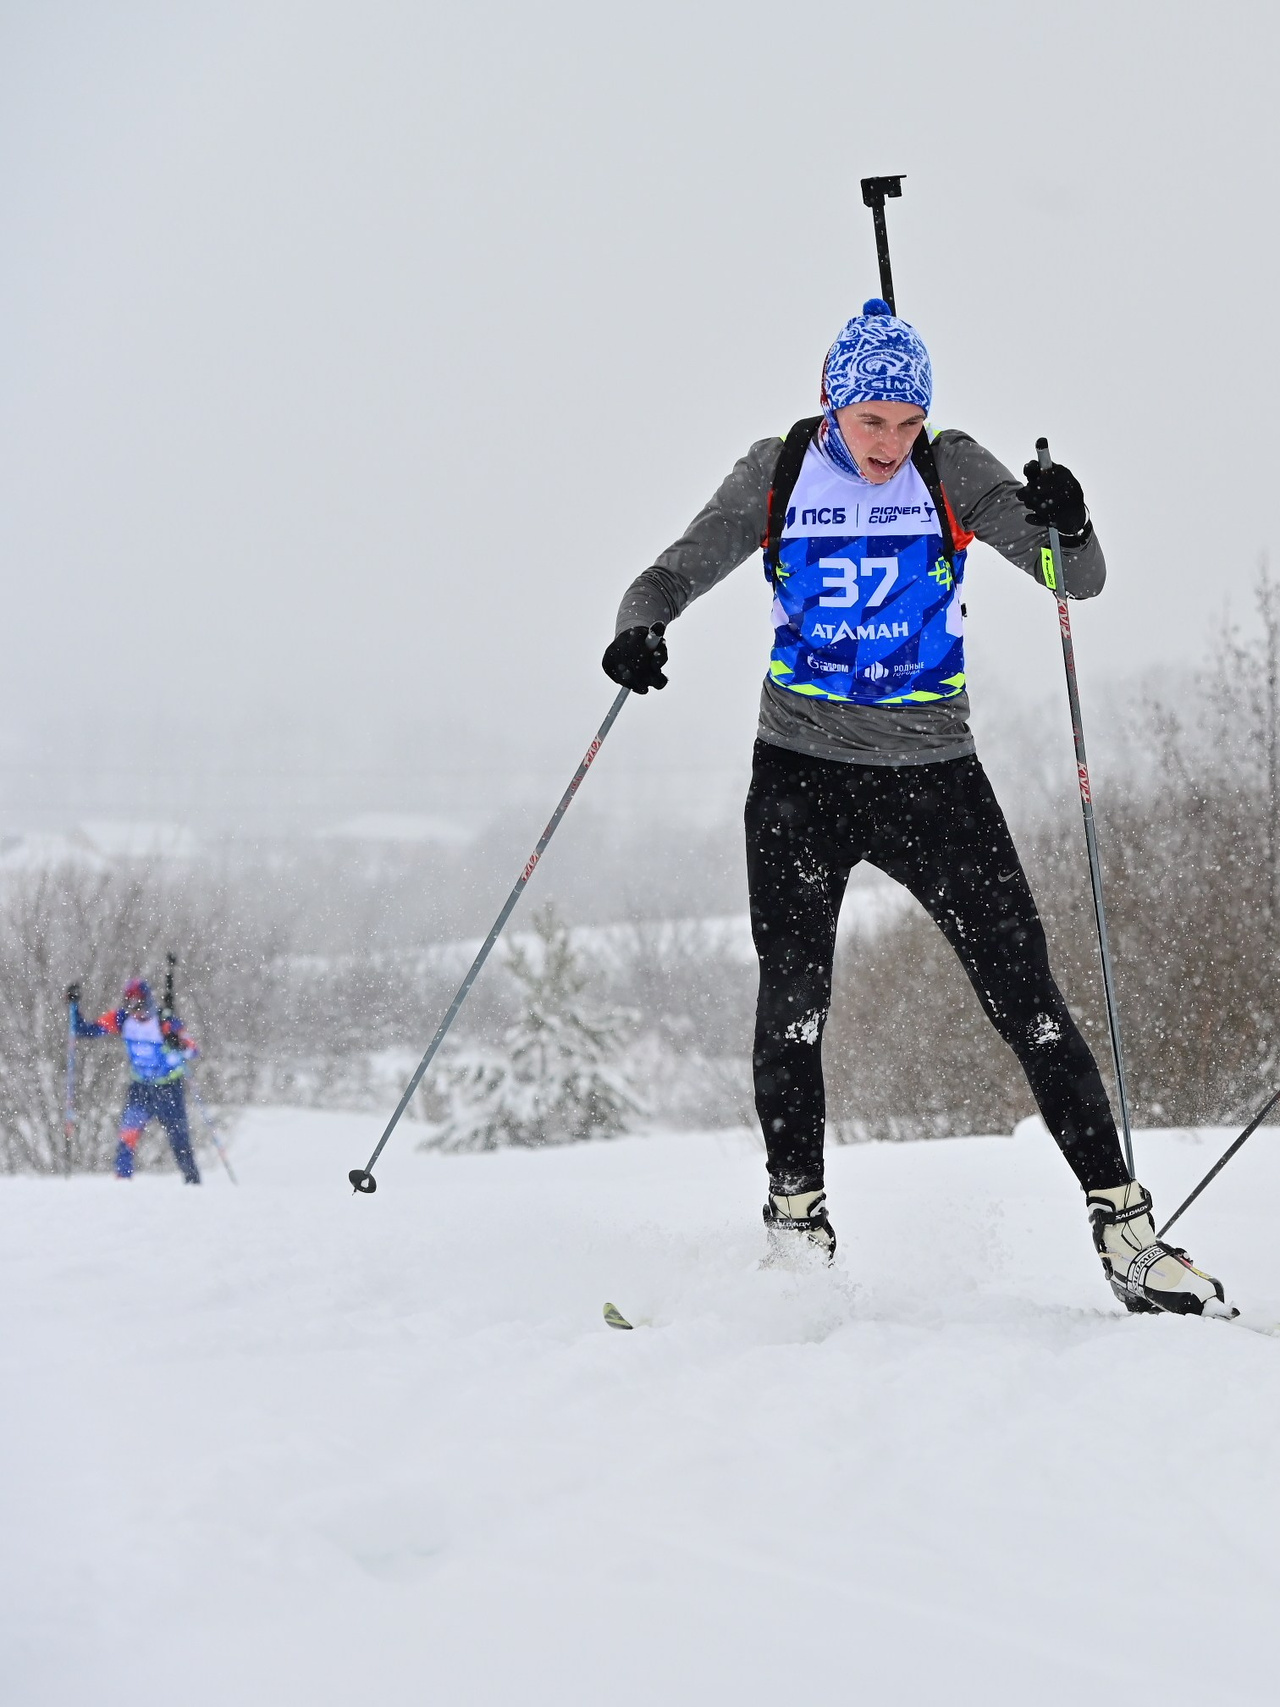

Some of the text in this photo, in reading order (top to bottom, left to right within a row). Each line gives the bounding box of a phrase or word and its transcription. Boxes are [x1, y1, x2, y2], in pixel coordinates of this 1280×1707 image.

[801, 507, 847, 526] ПСБ
[869, 505, 922, 516] PIONER
[868, 514, 898, 525] CUP
[818, 556, 899, 608] 37
[810, 619, 910, 645] АТАМАН
[893, 661, 925, 673] РОДНЫЕ
[1114, 1204, 1149, 1221] SALOMON
